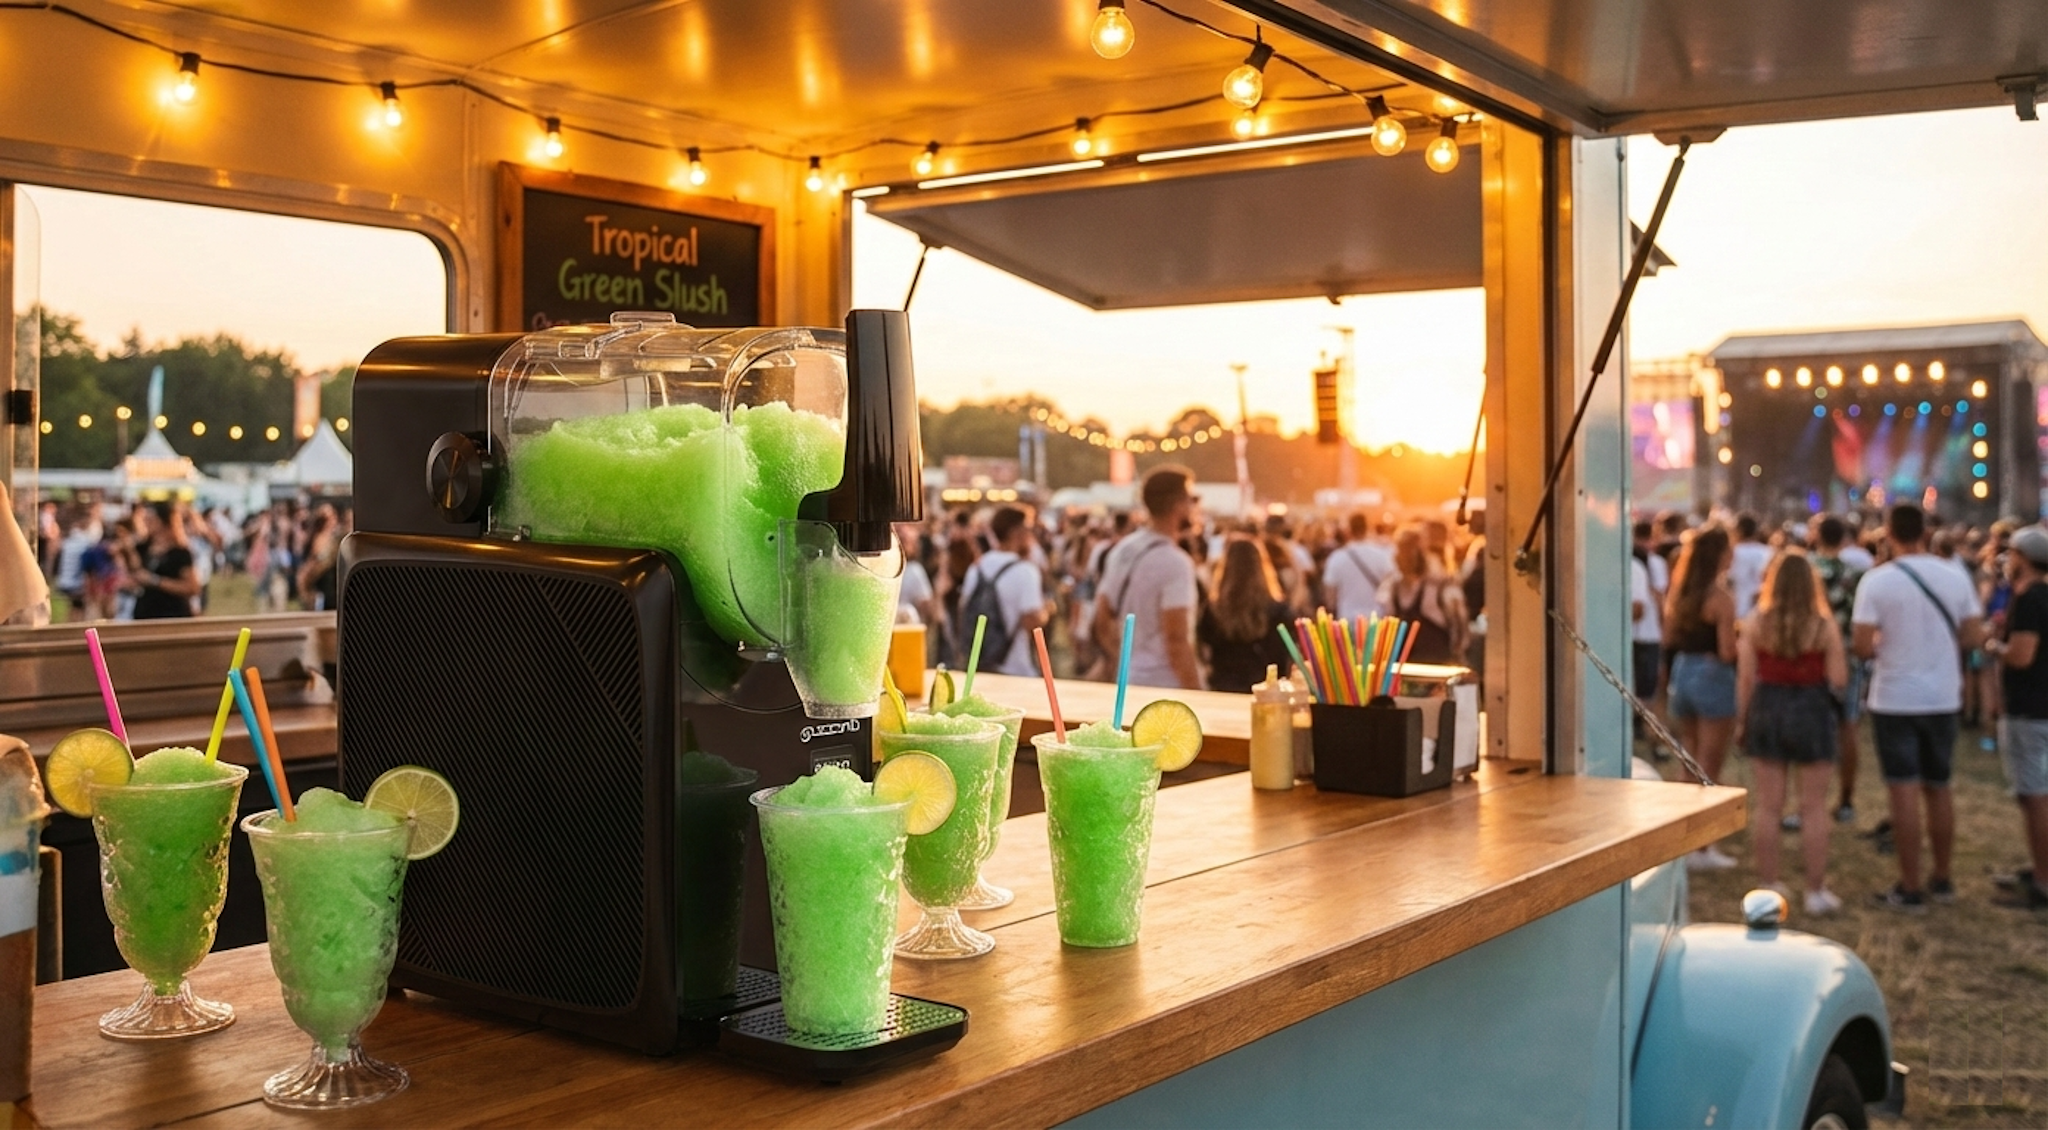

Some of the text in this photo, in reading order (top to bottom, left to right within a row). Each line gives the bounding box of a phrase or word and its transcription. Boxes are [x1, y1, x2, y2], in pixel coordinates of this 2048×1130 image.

[585, 215, 698, 271] Tropical
[558, 258, 728, 314] Green Slush
